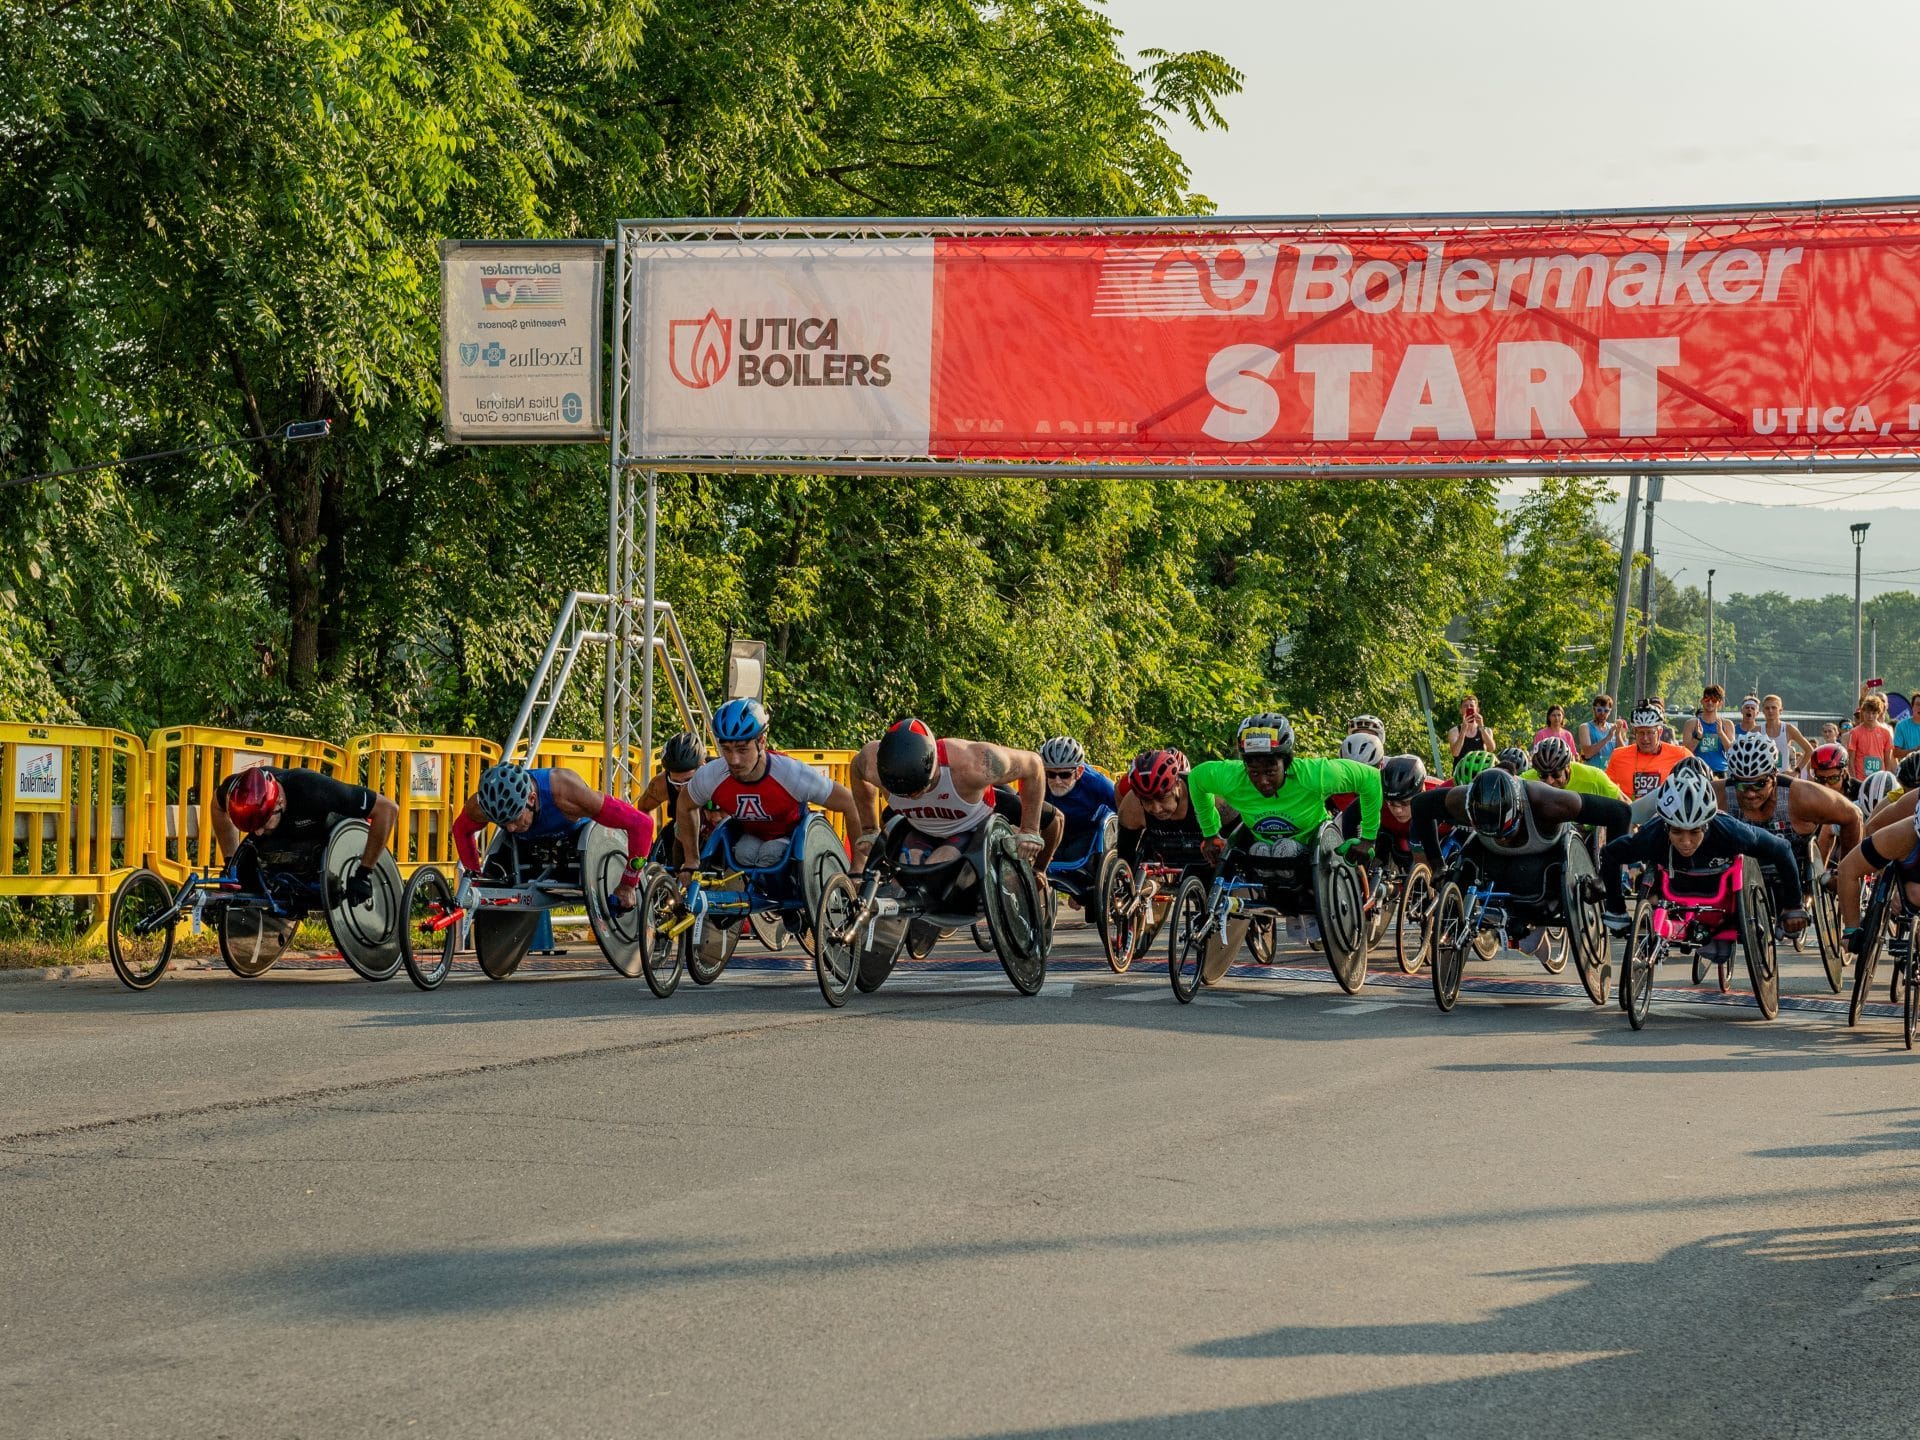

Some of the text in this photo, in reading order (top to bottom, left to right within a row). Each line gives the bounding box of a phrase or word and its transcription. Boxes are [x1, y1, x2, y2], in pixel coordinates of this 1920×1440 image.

[1289, 232, 1804, 315] Boilermaker
[739, 317, 838, 351] UTICA
[738, 353, 891, 388] BOILERS
[1202, 337, 1680, 443] START
[1752, 405, 1892, 437] UTICA,
[1702, 737, 1715, 747] 634
[1867, 760, 1880, 770] 318
[20, 772, 57, 793] Boilermaker
[1634, 776, 1660, 789] 5527
[732, 794, 773, 821] A
